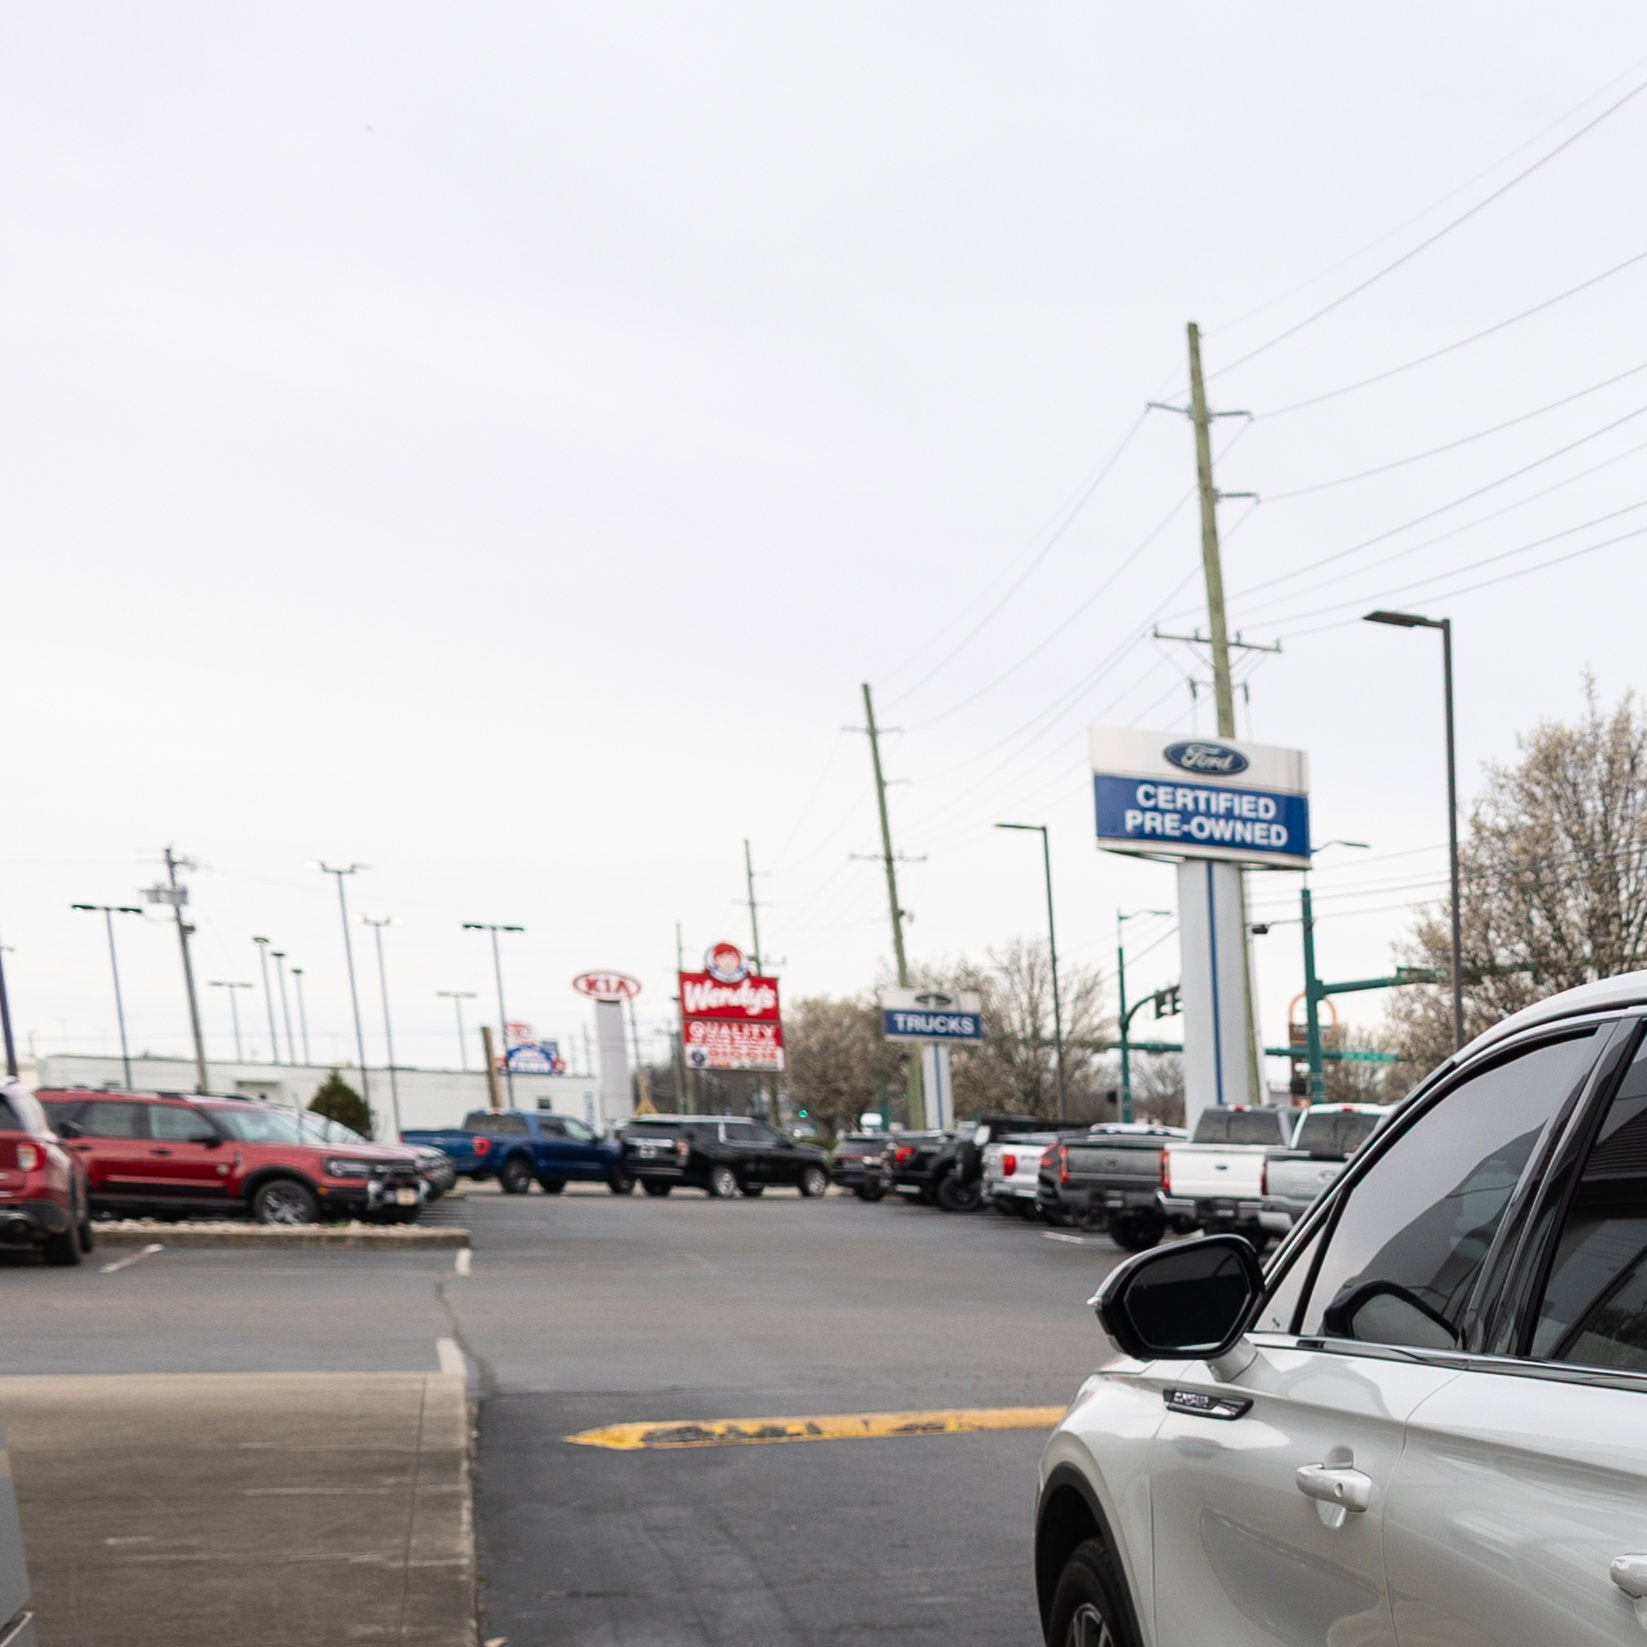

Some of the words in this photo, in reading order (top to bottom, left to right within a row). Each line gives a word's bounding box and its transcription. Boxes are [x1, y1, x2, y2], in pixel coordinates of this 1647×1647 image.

[1180, 744, 1233, 771] Ford
[1135, 784, 1277, 821] CERTIFIED
[1124, 809, 1289, 848] PRE-OWNED
[585, 977, 630, 994] KIA
[683, 978, 776, 1016] Wendy's
[688, 1021, 777, 1038] QUALITY
[893, 1013, 975, 1035] TRUCKS
